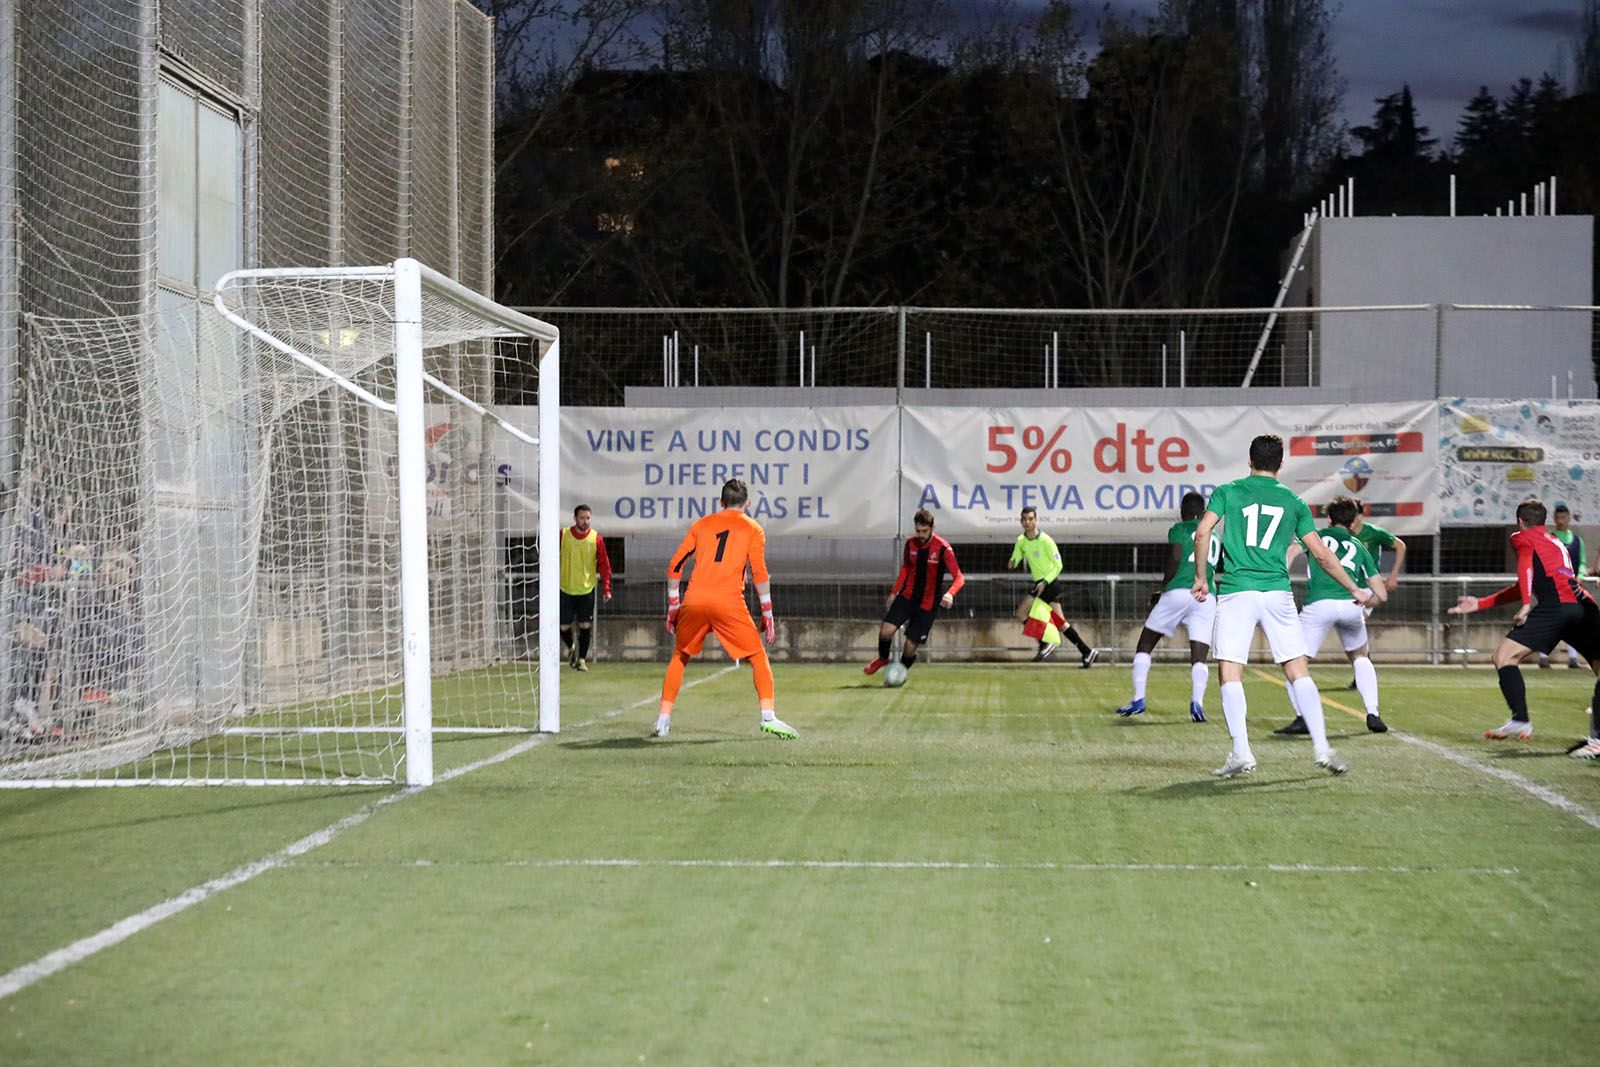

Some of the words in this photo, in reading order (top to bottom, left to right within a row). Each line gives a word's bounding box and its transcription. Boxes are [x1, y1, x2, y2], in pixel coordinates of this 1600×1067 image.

[586, 429, 655, 452] VINE
[668, 430, 688, 452] A
[698, 430, 741, 452] UN
[754, 428, 870, 452] CONDIS
[986, 424, 1073, 474] 5%
[1093, 422, 1205, 474] dte.
[645, 463, 790, 486] DIFERENT
[803, 463, 809, 486] I
[798, 496, 830, 519] EL
[918, 483, 941, 510] A
[952, 483, 990, 510] LA
[1000, 484, 1084, 510] TEVA
[1242, 503, 1285, 551] 17
[715, 529, 730, 563] 1
